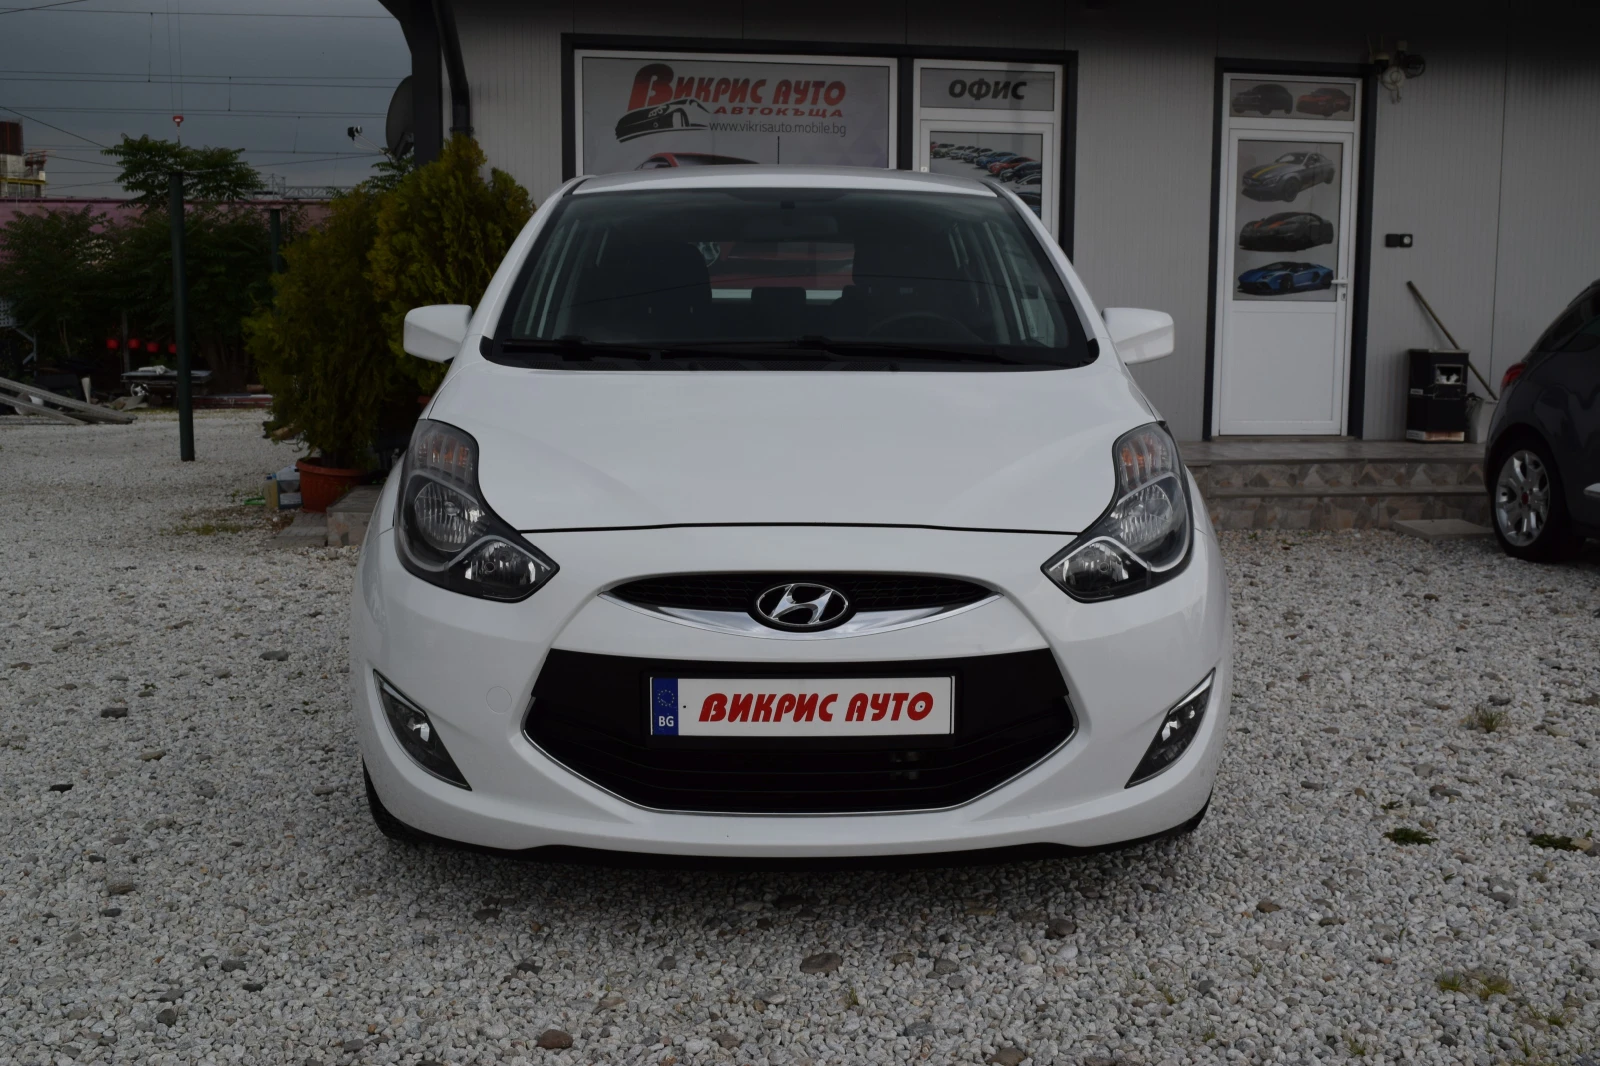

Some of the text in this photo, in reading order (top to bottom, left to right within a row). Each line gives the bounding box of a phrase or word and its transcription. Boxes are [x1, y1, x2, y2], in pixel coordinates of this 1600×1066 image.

[627, 63, 846, 112] ВИКРИС АУТО
[948, 78, 1027, 101] ОФИС
[713, 105, 843, 118] АВТОКЪЩА
[709, 120, 846, 137] www.vikrisauto.mobile.bg
[698, 691, 934, 723] ВИКРИС АУТО
[658, 715, 675, 728] BG
